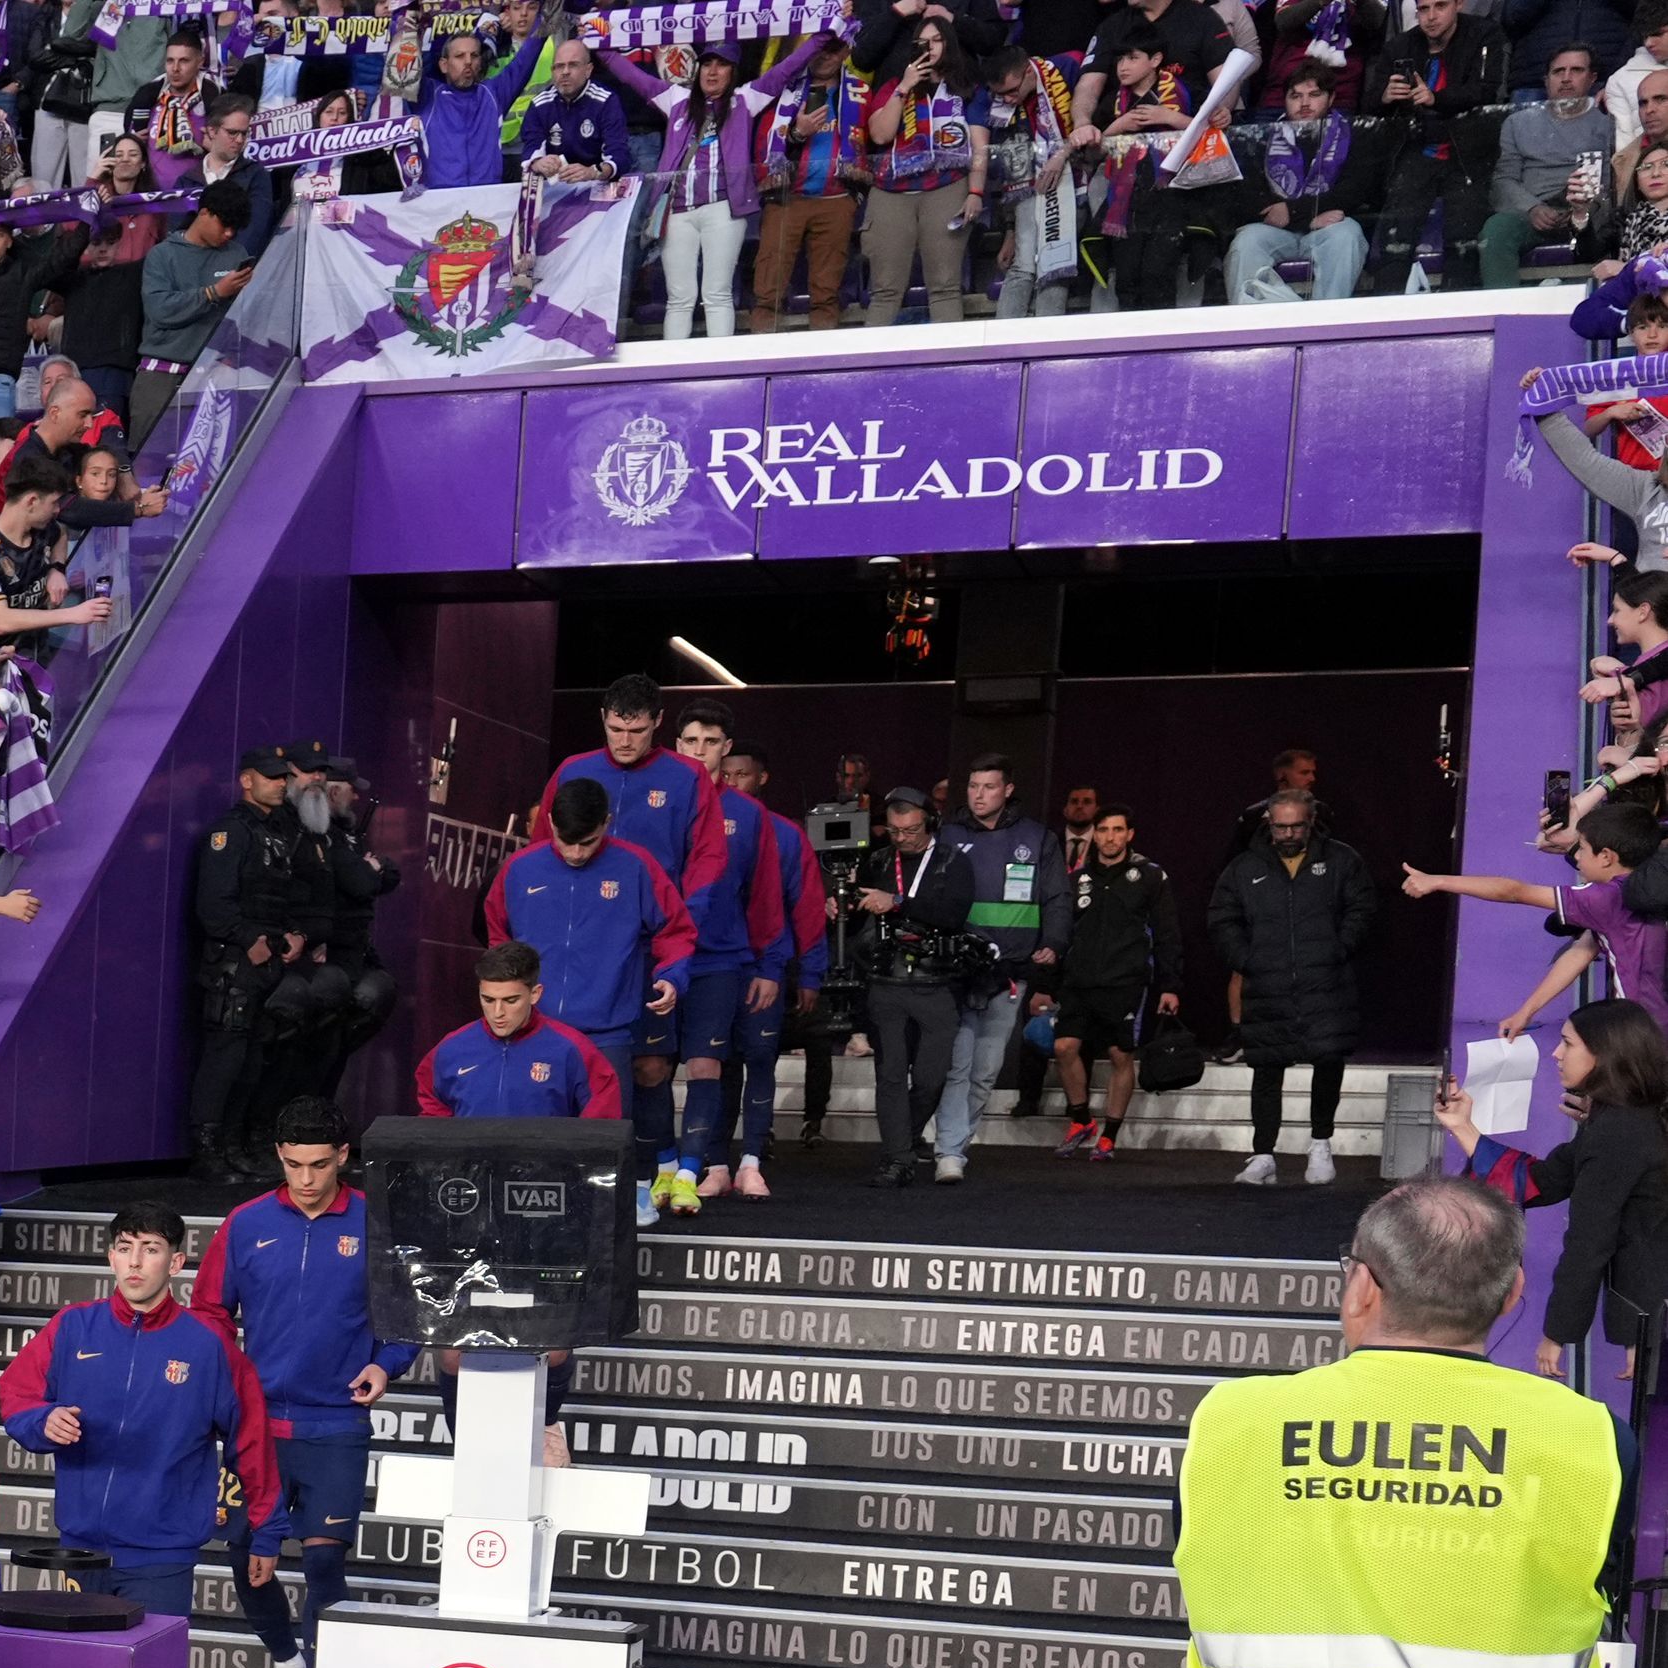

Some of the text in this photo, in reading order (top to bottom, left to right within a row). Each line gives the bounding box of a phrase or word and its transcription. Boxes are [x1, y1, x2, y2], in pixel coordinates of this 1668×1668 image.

[244, 133, 293, 161] Real
[708, 418, 905, 471] REAL
[706, 446, 1223, 513] VALLADOLID
[511, 1189, 559, 1207] VAR
[685, 1248, 1340, 1308] LUCHA POR UN SENTIMIENTO, GANA POR
[684, 1307, 1271, 1366] DE GLORIA. TU ENTREGA EN CADA
[574, 1360, 1187, 1422] FUIMOS, IMAGINA LO QUE SEREMOS.
[1061, 1440, 1173, 1478] LUCHA
[1280, 1419, 1508, 1476] EULEN
[16, 1500, 51, 1533] DE
[1282, 1475, 1504, 1511] SEGURIDAD
[975, 1505, 1163, 1549] UN PASADO
[570, 1536, 1099, 1614] FÚTBOL ENTREGA EN
[658, 1614, 808, 1662] IMAGINA
[827, 1628, 869, 1664] LO
